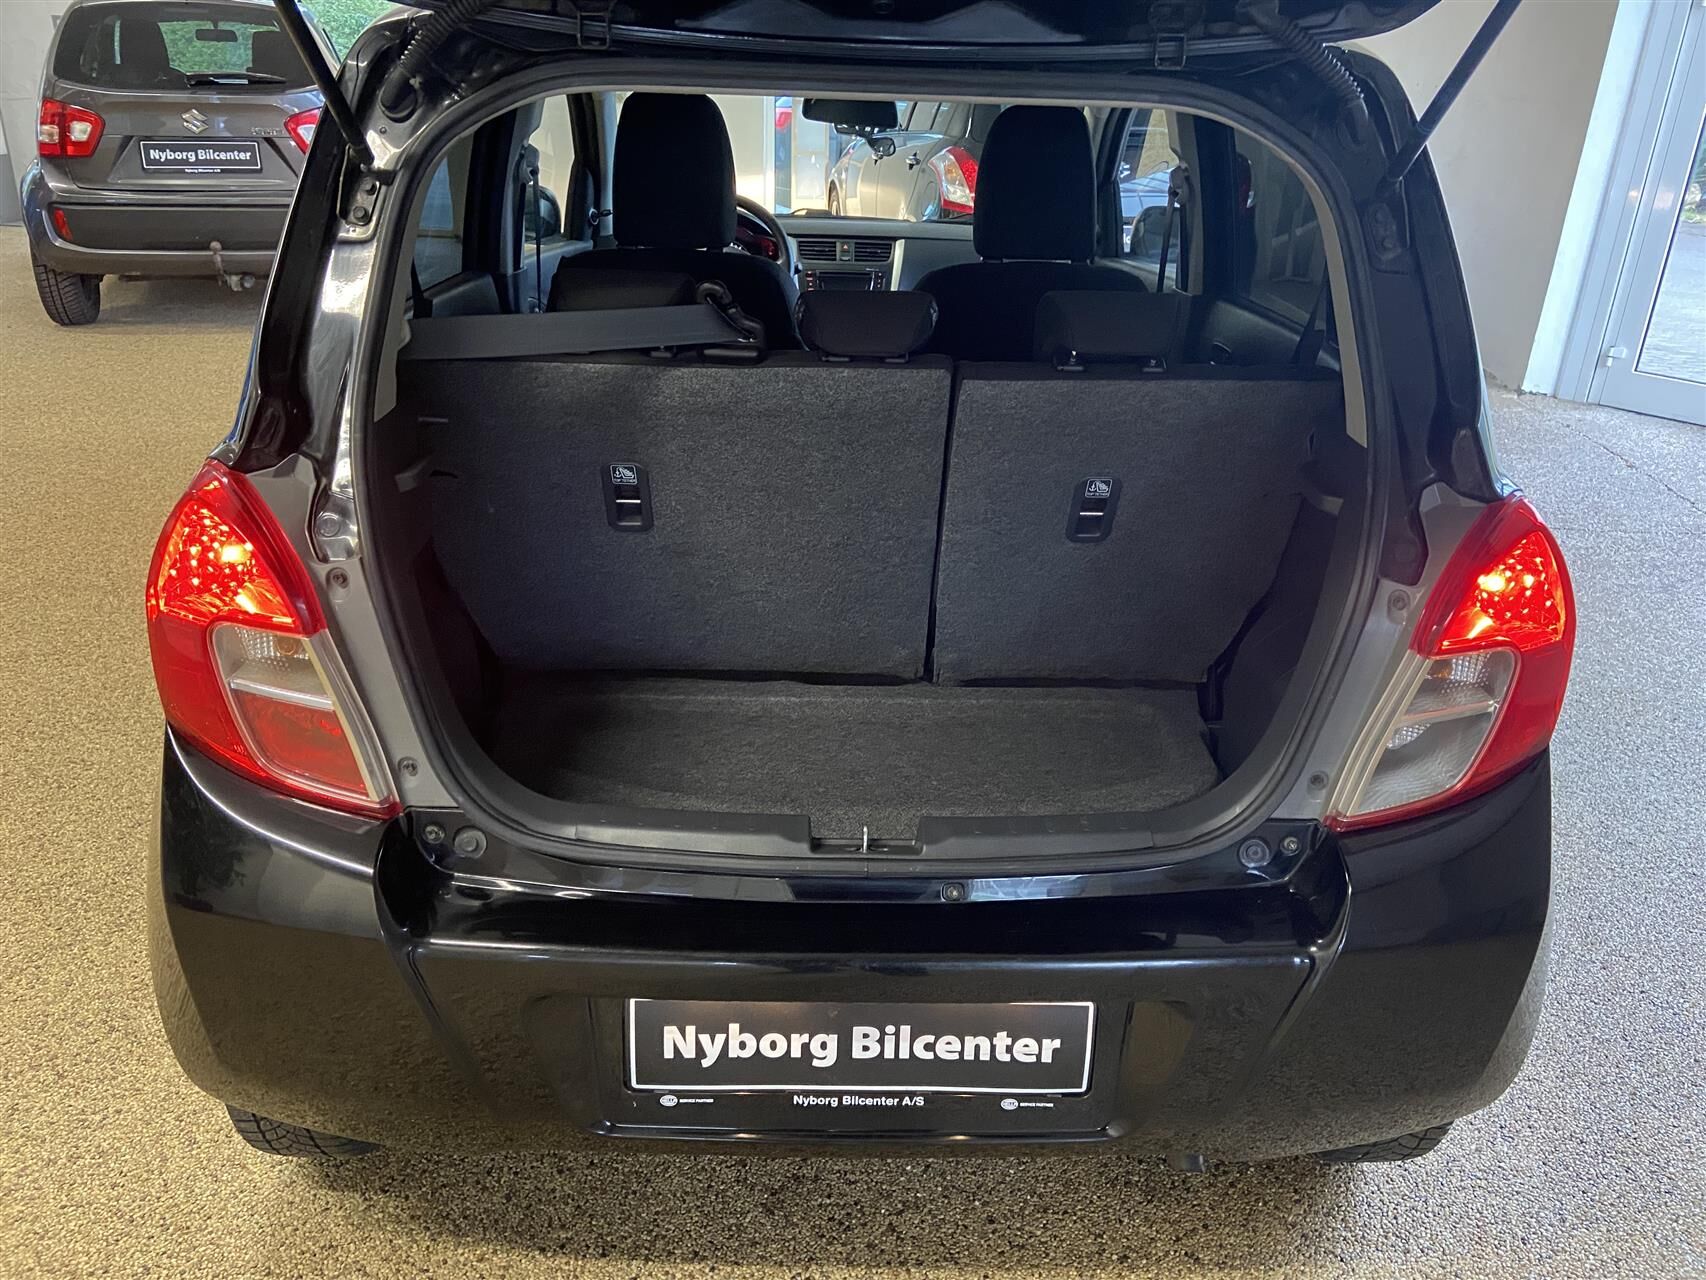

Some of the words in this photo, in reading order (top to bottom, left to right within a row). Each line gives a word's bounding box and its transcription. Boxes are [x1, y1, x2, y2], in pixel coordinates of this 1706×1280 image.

[149, 149, 196, 162] Nyborg
[197, 149, 252, 160] Bilcenter
[663, 1023, 838, 1068] Nyborg
[851, 1024, 1061, 1063] Bilcenter
[793, 1095, 838, 1107] Nyborg
[842, 1095, 899, 1106] Bilcenter
[902, 1096, 925, 1106] A/S
